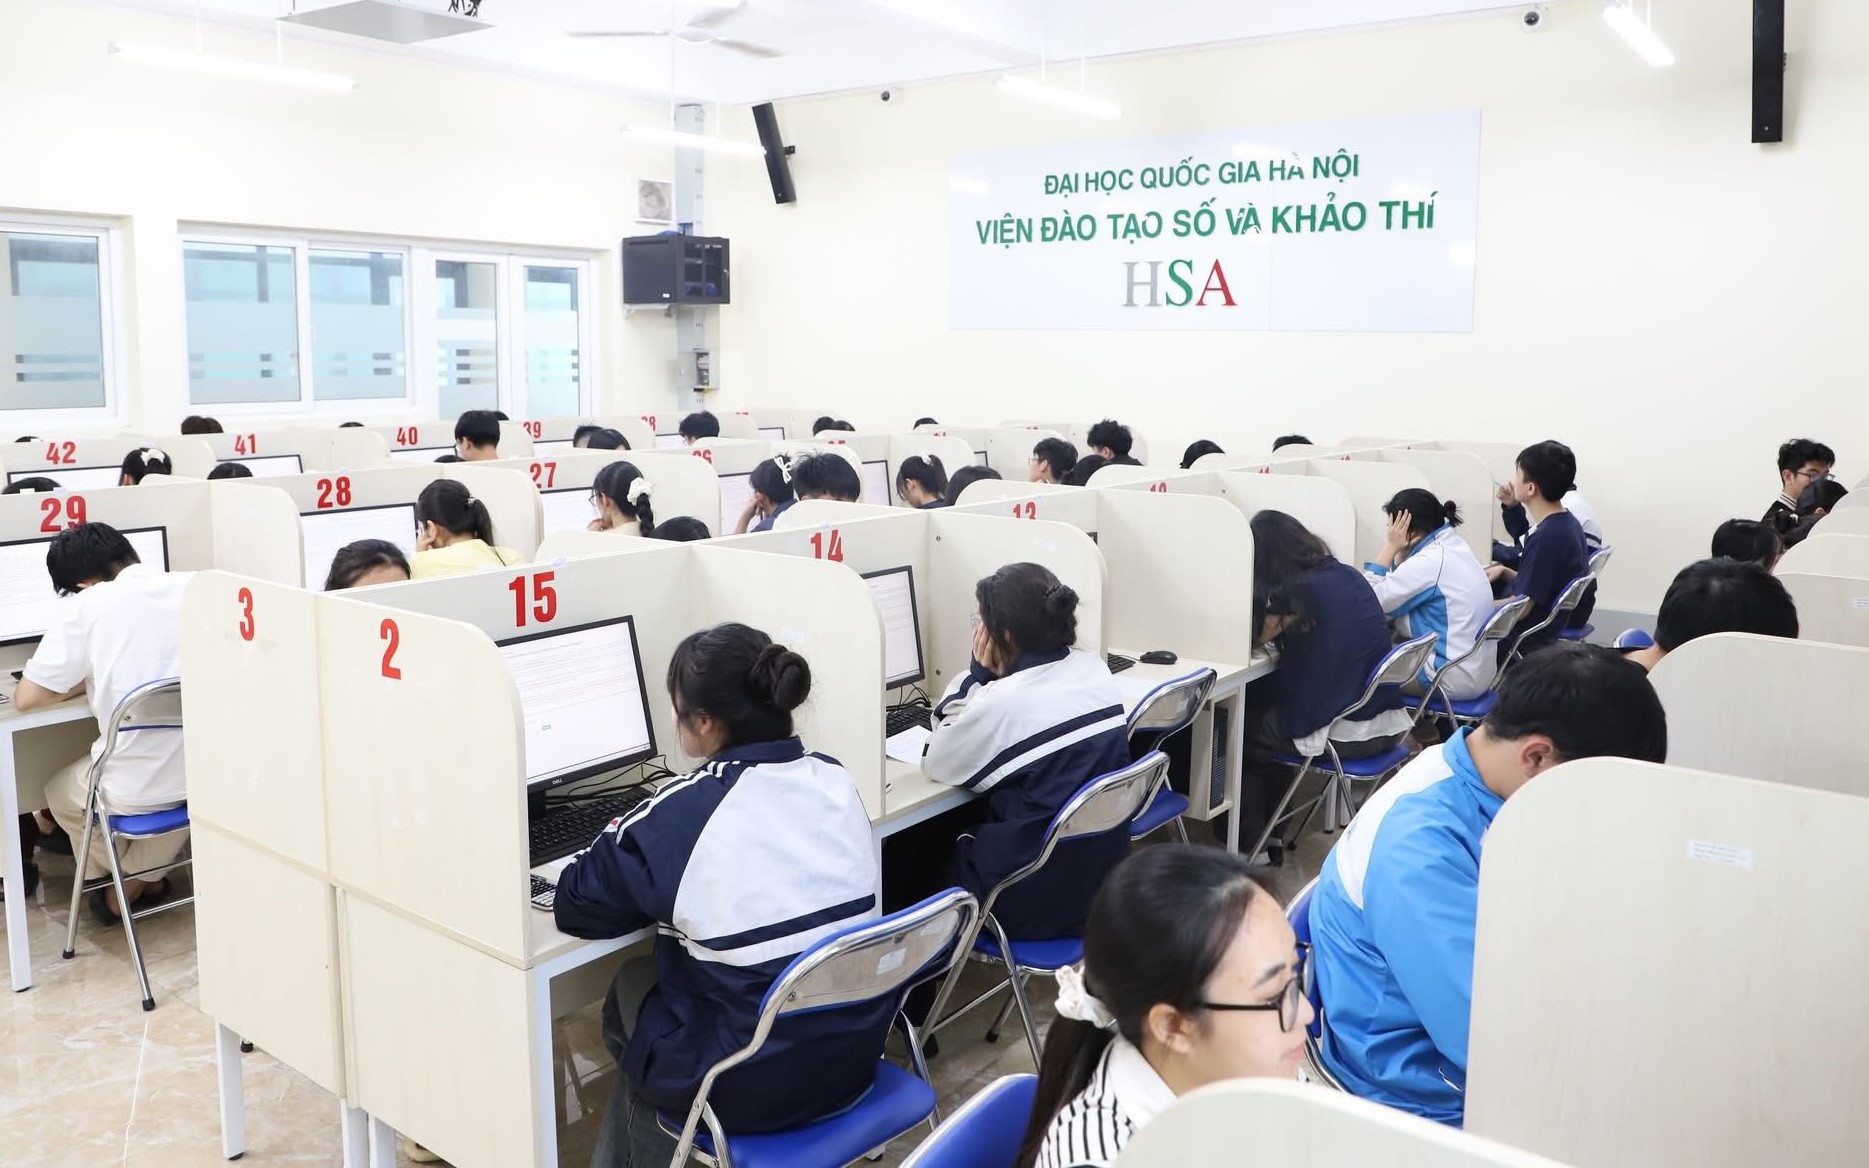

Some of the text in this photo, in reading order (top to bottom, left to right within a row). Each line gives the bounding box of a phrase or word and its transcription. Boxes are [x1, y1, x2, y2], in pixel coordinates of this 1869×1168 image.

[1044, 148, 1359, 198] ĐẠI HỌC QUỐC GIA HÀ NỘI
[976, 190, 1439, 249] VIỆN ĐÀO TẠO SỐ VÀ KHẢO THÍ
[1121, 258, 1239, 308] HSA
[45, 440, 77, 465] 42
[235, 433, 257, 456] 41
[396, 426, 419, 446] 40
[316, 475, 352, 509] 28
[529, 461, 557, 490] 27
[40, 494, 87, 533] 29
[811, 528, 844, 563] 14
[238, 586, 255, 642] 3
[508, 570, 558, 628] 15
[380, 618, 402, 681] 2
